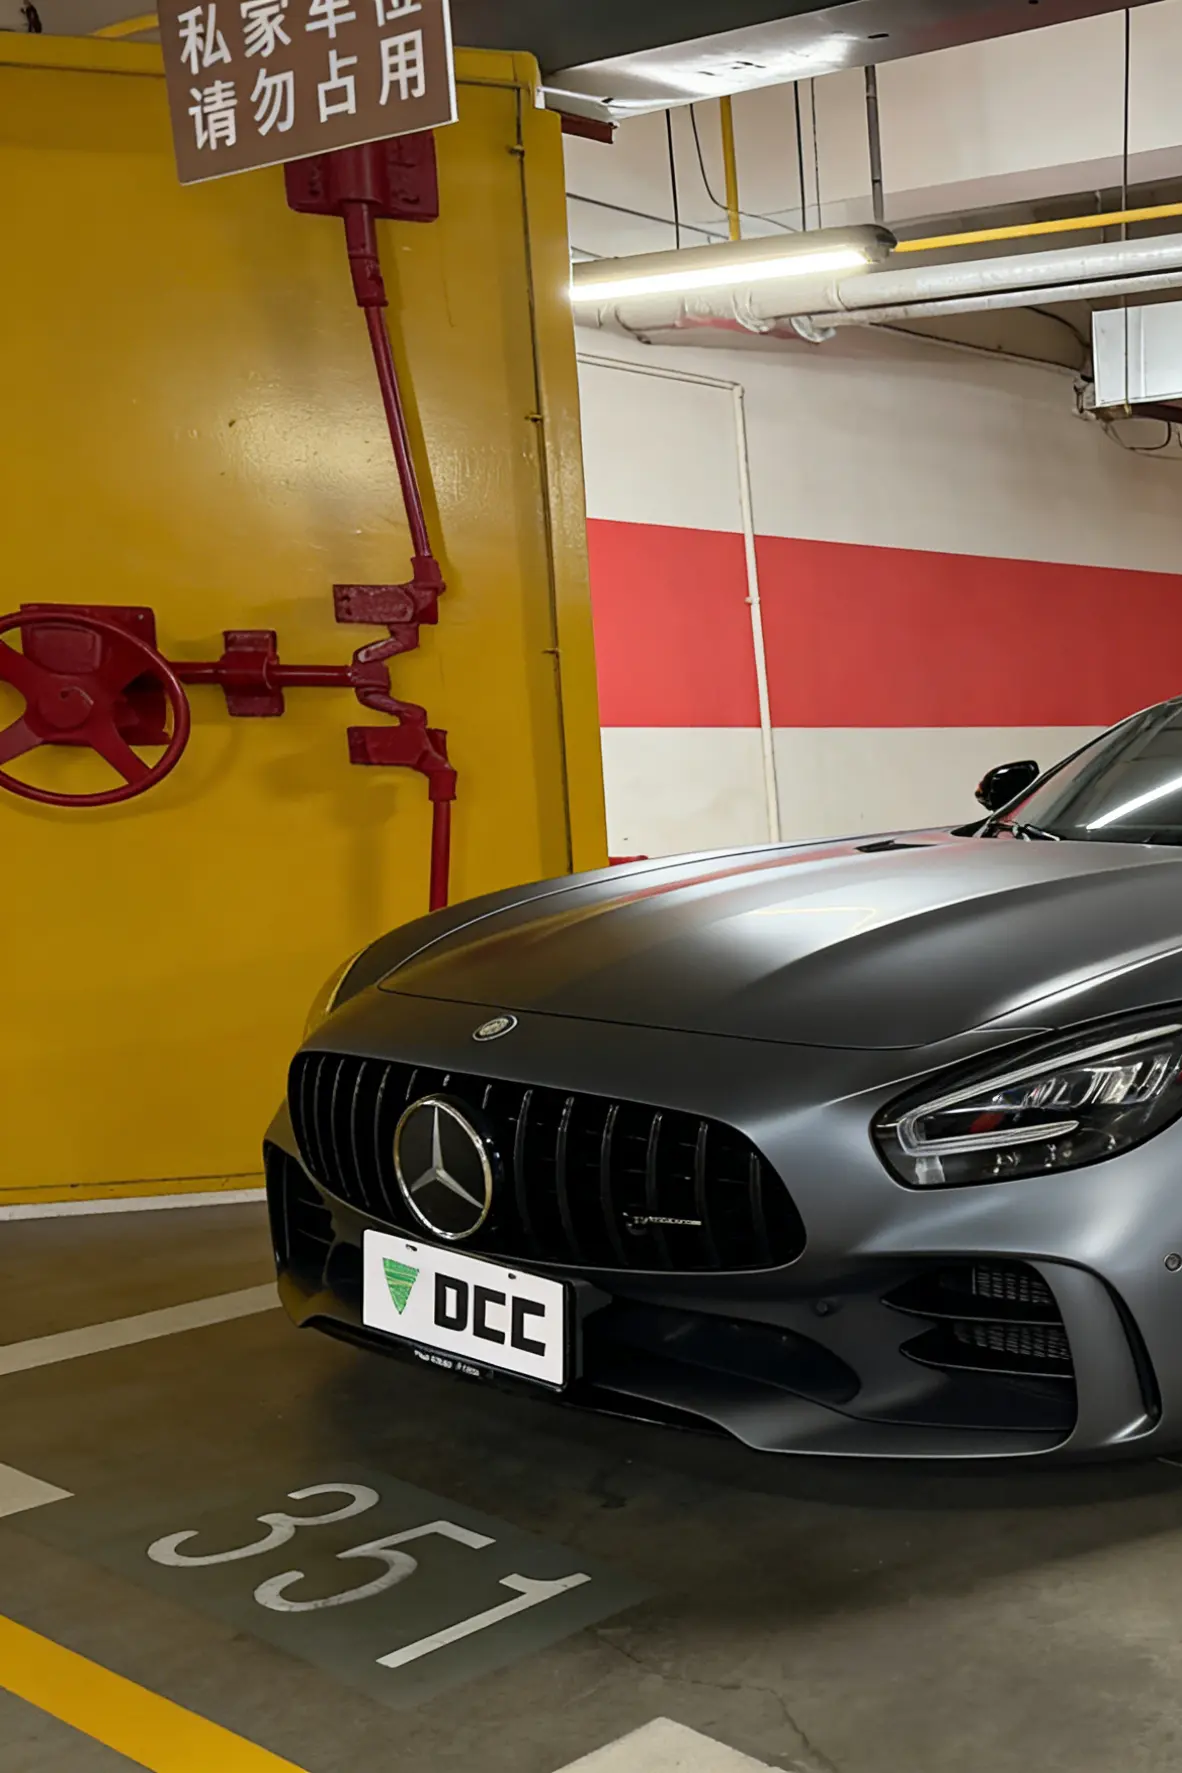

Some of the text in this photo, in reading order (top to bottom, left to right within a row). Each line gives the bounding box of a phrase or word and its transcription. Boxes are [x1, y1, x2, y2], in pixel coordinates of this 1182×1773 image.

[188, 29, 427, 151] 请勿占用
[434, 1272, 547, 1357] DCC
[147, 1482, 592, 1669] 351
